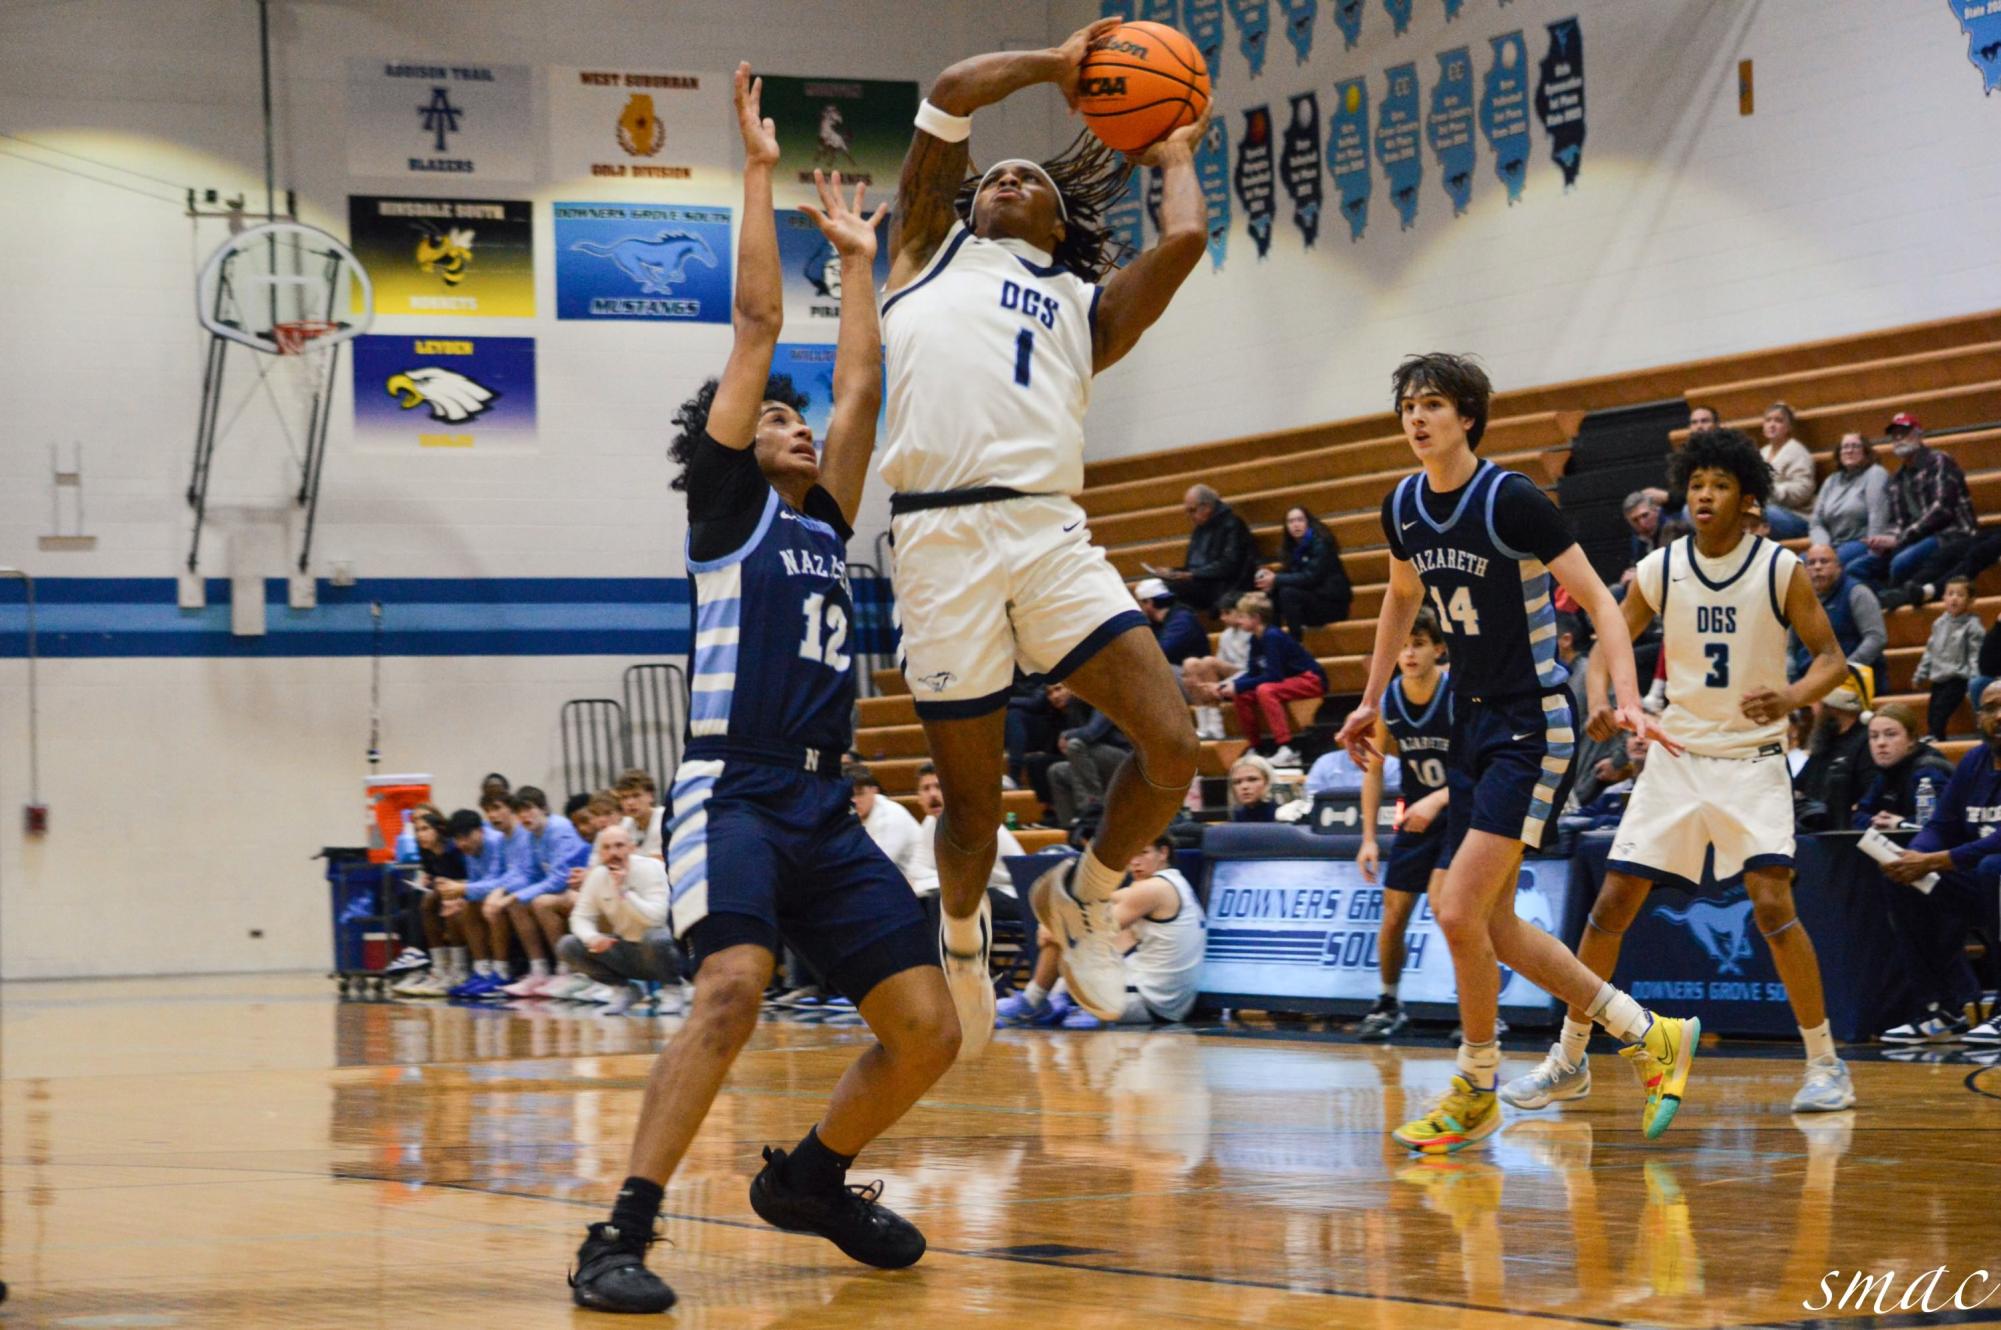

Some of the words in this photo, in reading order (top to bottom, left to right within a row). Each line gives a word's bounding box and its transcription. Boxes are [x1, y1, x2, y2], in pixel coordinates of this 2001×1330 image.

[581, 72, 620, 87] WEST
[625, 74, 700, 90] SUBURBAN
[591, 164, 627, 177] GOLD
[632, 165, 692, 179] DIVISION
[630, 208, 678, 222] GROVE
[684, 211, 732, 224] SOUTH
[590, 298, 701, 317] MUSTANGS
[1001, 279, 1060, 330] DGS
[1014, 327, 1035, 389] 1
[1430, 585, 1481, 636] 14
[1697, 605, 1737, 634] DGS
[798, 591, 852, 673] 12
[1704, 642, 1730, 689] 3
[804, 748, 821, 773] N
[1407, 757, 1447, 788] 10
[1216, 888, 1342, 920] DOWNERS
[1348, 888, 1436, 922] GRE
[1323, 930, 1429, 972] SOUH
[1631, 980, 1705, 1001] DOWNERS
[1709, 981, 1762, 1001] GROVE
[1765, 982, 1789, 1002] SO
